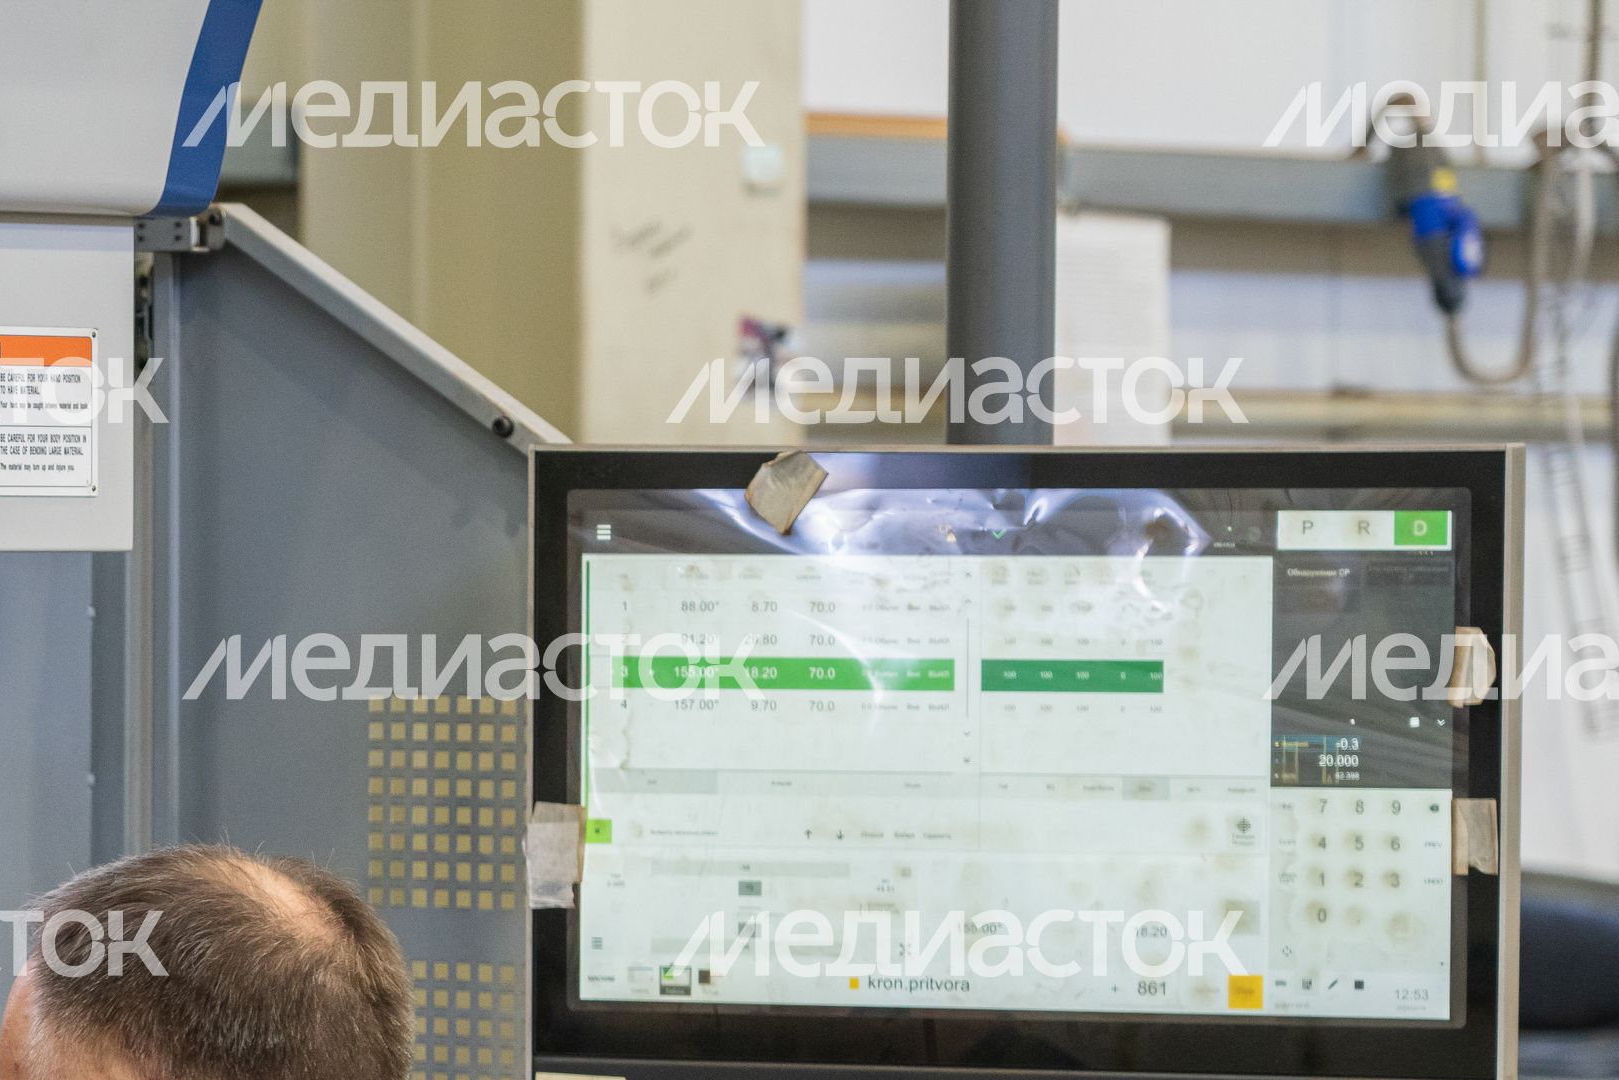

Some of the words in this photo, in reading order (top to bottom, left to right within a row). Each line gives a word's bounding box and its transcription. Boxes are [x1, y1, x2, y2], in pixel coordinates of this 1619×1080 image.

[0, 433, 6, 442] BE
[7, 434, 25, 443] CAREFUL
[27, 434, 35, 443] FOR
[37, 434, 48, 443] YOUR
[50, 434, 61, 443] BODY
[63, 434, 80, 443] POSITION
[83, 434, 87, 443] IN
[0, 446, 8, 455] THE
[10, 446, 20, 455] CASE
[22, 446, 27, 455] OF
[30, 446, 47, 455] BENDING
[48, 446, 62, 455] LARGE
[1302, 520, 1314, 535] P
[1358, 520, 1370, 535] R
[1413, 520, 1427, 535] D
[622, 602, 628, 612] 1
[751, 602, 778, 613] 8.70
[809, 602, 836, 613] 70.0
[809, 634, 836, 645] 70.0
[809, 667, 836, 679] 70.0
[621, 700, 628, 711] 4
[751, 700, 777, 711] 9.70
[809, 700, 835, 711] 70.0
[1318, 799, 1327, 813] 7
[1355, 800, 1364, 814] 8
[1392, 800, 1401, 814] 9
[1318, 836, 1327, 849] 4
[1355, 836, 1364, 850] 5
[1391, 837, 1400, 850] 6
[1319, 872, 1325, 886] 1
[1354, 873, 1364, 887] 2
[1391, 874, 1400, 887] 3
[1317, 909, 1326, 922] 0
[867, 975, 970, 994] kron.pritvora
[1137, 980, 1167, 995] 861
[1395, 989, 1429, 1001] 12:53
